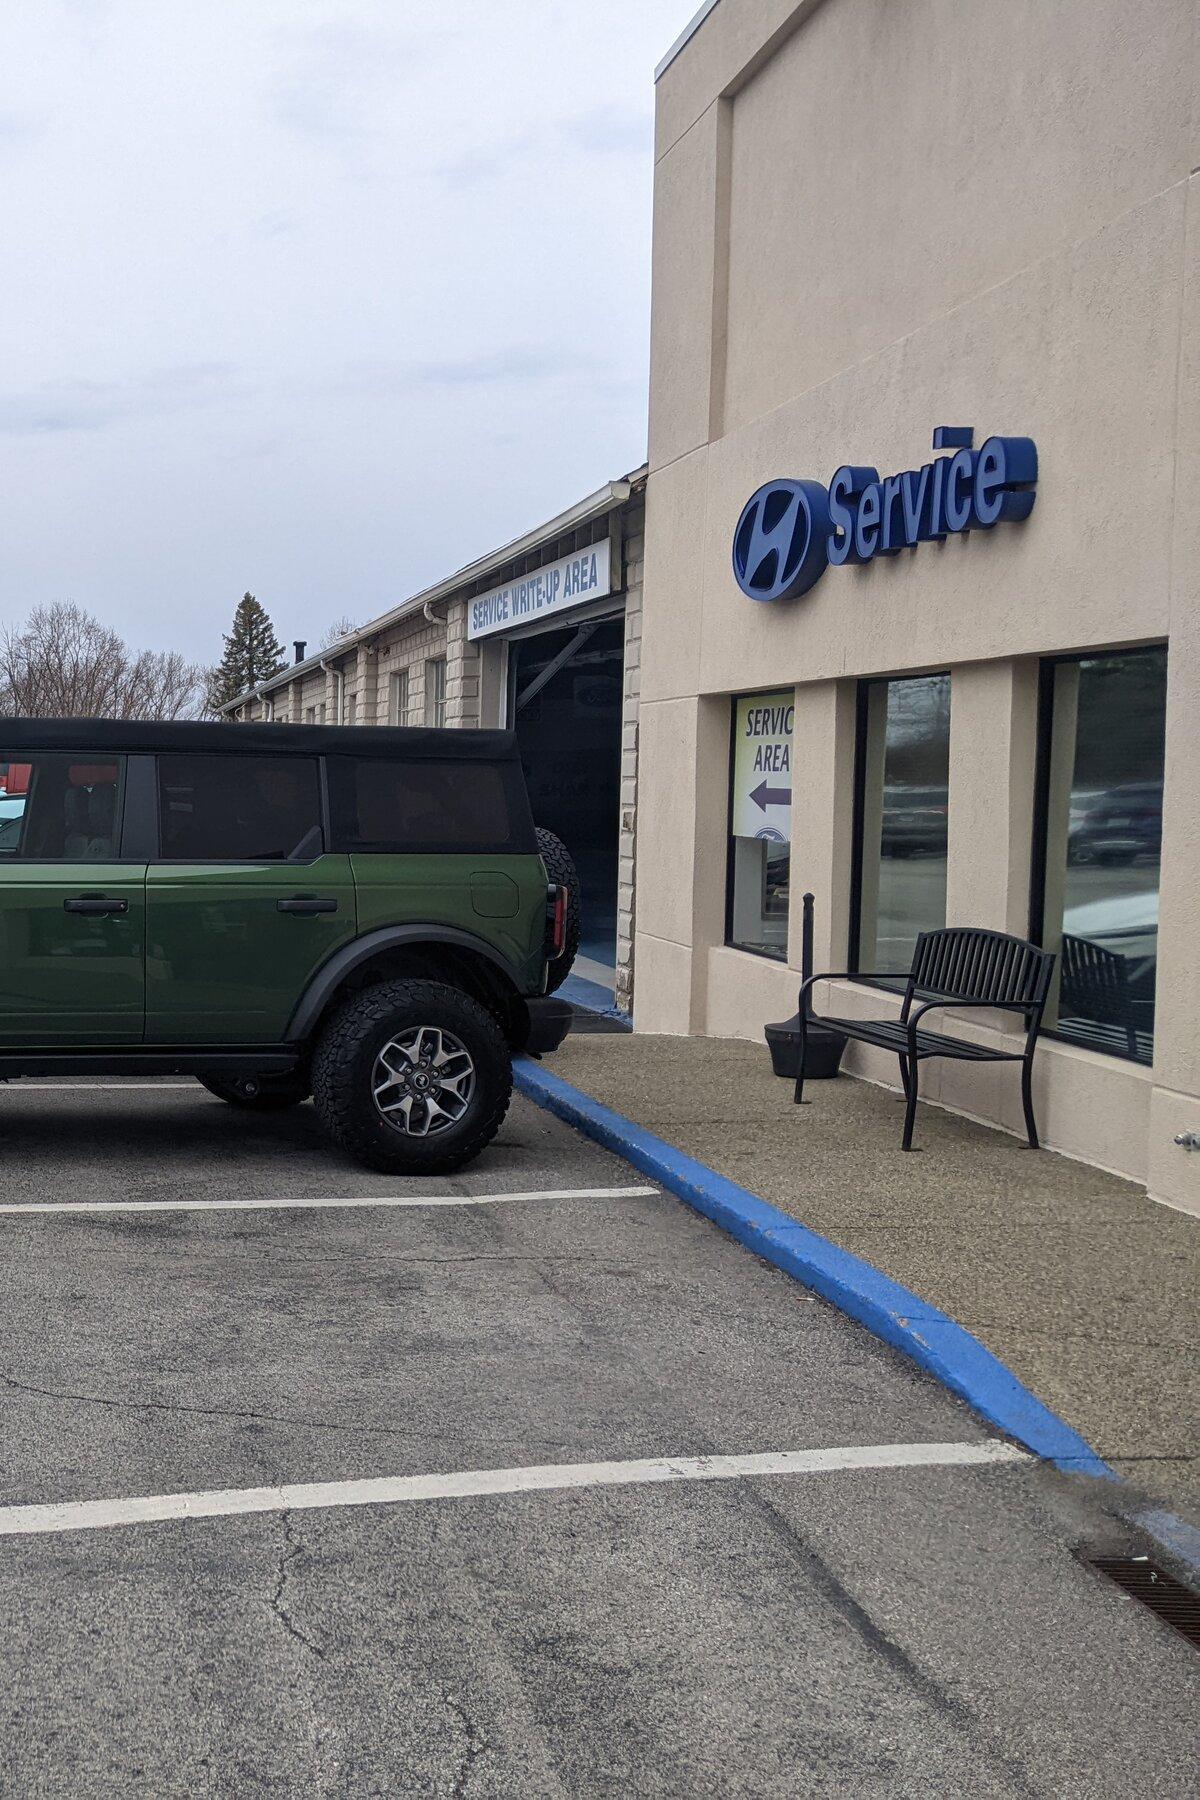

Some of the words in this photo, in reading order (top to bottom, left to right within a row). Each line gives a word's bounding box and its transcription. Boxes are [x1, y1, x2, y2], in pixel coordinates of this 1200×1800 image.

[827, 426, 1038, 566] Service
[472, 590, 509, 631] SERVICE
[511, 569, 560, 617] WRITE-UP
[563, 553, 598, 598] AREA
[746, 705, 795, 737] SERVIC
[753, 744, 790, 772] AREA
